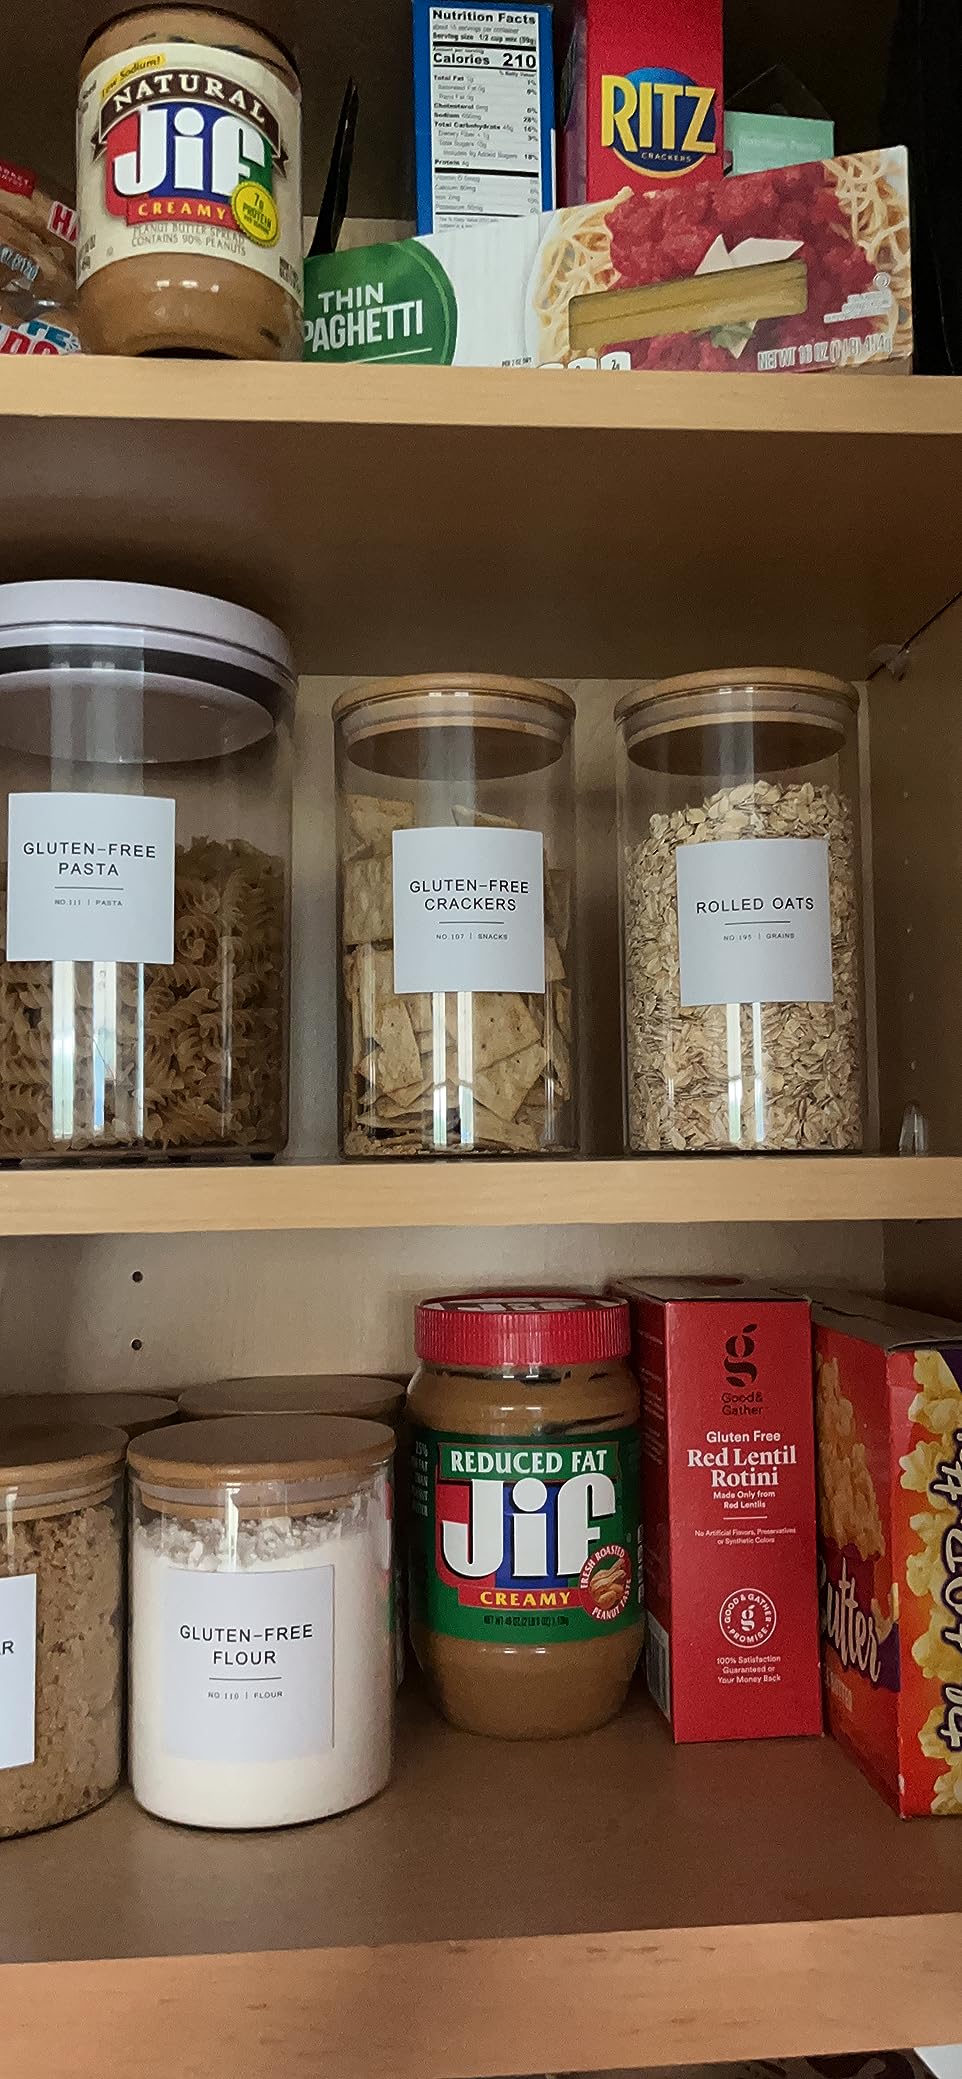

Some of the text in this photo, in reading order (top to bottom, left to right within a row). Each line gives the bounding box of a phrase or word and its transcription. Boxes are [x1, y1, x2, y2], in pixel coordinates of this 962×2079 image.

[433, 10, 536, 25] Nutrition Facts
[433, 32, 459, 40] Serving
[120, 56, 160, 78] Sodium!
[433, 52, 537, 68] Calories 210
[113, 73, 265, 125] NATURAL
[601, 74, 716, 153] RITZ
[454, 122, 501, 130] Carbohydrate
[113, 104, 265, 197] Jif
[641, 152, 692, 162] CRACKERS
[138, 201, 226, 220] CREAMY
[134, 223, 168, 236] PEANUT
[172, 223, 206, 235] BUTTER
[132, 233, 178, 248] CONTAINS
[206, 237, 246, 257] PEANUTS
[318, 282, 383, 313] THIN
[303, 299, 423, 352] PAGHETTI
[758, 351, 777, 370] NET
[778, 347, 796, 367] WT
[23, 842, 156, 859] GLUTEN-FREE
[58, 862, 119, 876] PASTA
[409, 879, 529, 894] GLUTEN-FREE
[424, 897, 516, 911] CRACKERS
[696, 897, 814, 914] ROLLED OATS
[766, 932, 795, 940] GRAINS
[721, 1404, 763, 1416] Gather
[706, 1430, 781, 1443] Gluten Free
[450, 1450, 607, 1474] REDUCED FAT
[687, 1445, 797, 1467] Red Lentil
[711, 1466, 779, 1487] Rotini
[713, 1491, 735, 1499] Made
[737, 1490, 756, 1499] Only
[443, 1473, 616, 1578] Jif
[757, 1527, 796, 1535] Preservatives
[725, 1537, 753, 1546] Synthetic
[755, 1536, 775, 1544] Colors
[580, 1545, 625, 1589] FRESH ROASTED
[480, 1590, 571, 1606] CREAMY
[591, 1578, 631, 1620] PEANUT TASTE
[724, 1597, 740, 1623] GOOD
[747, 1593, 772, 1623] GATHER
[820, 1556, 881, 1682] utter
[180, 1623, 313, 1642] GLUTEN-FREE
[728, 1627, 768, 1643] PROMISE
[213, 1650, 276, 1665] FLOUR
[717, 1655, 781, 1665] 100% Satisfaction
[722, 1665, 766, 1674] Guaranteed
[718, 1674, 781, 1684] Your Money Back
[253, 1691, 283, 1699] FLOUR
